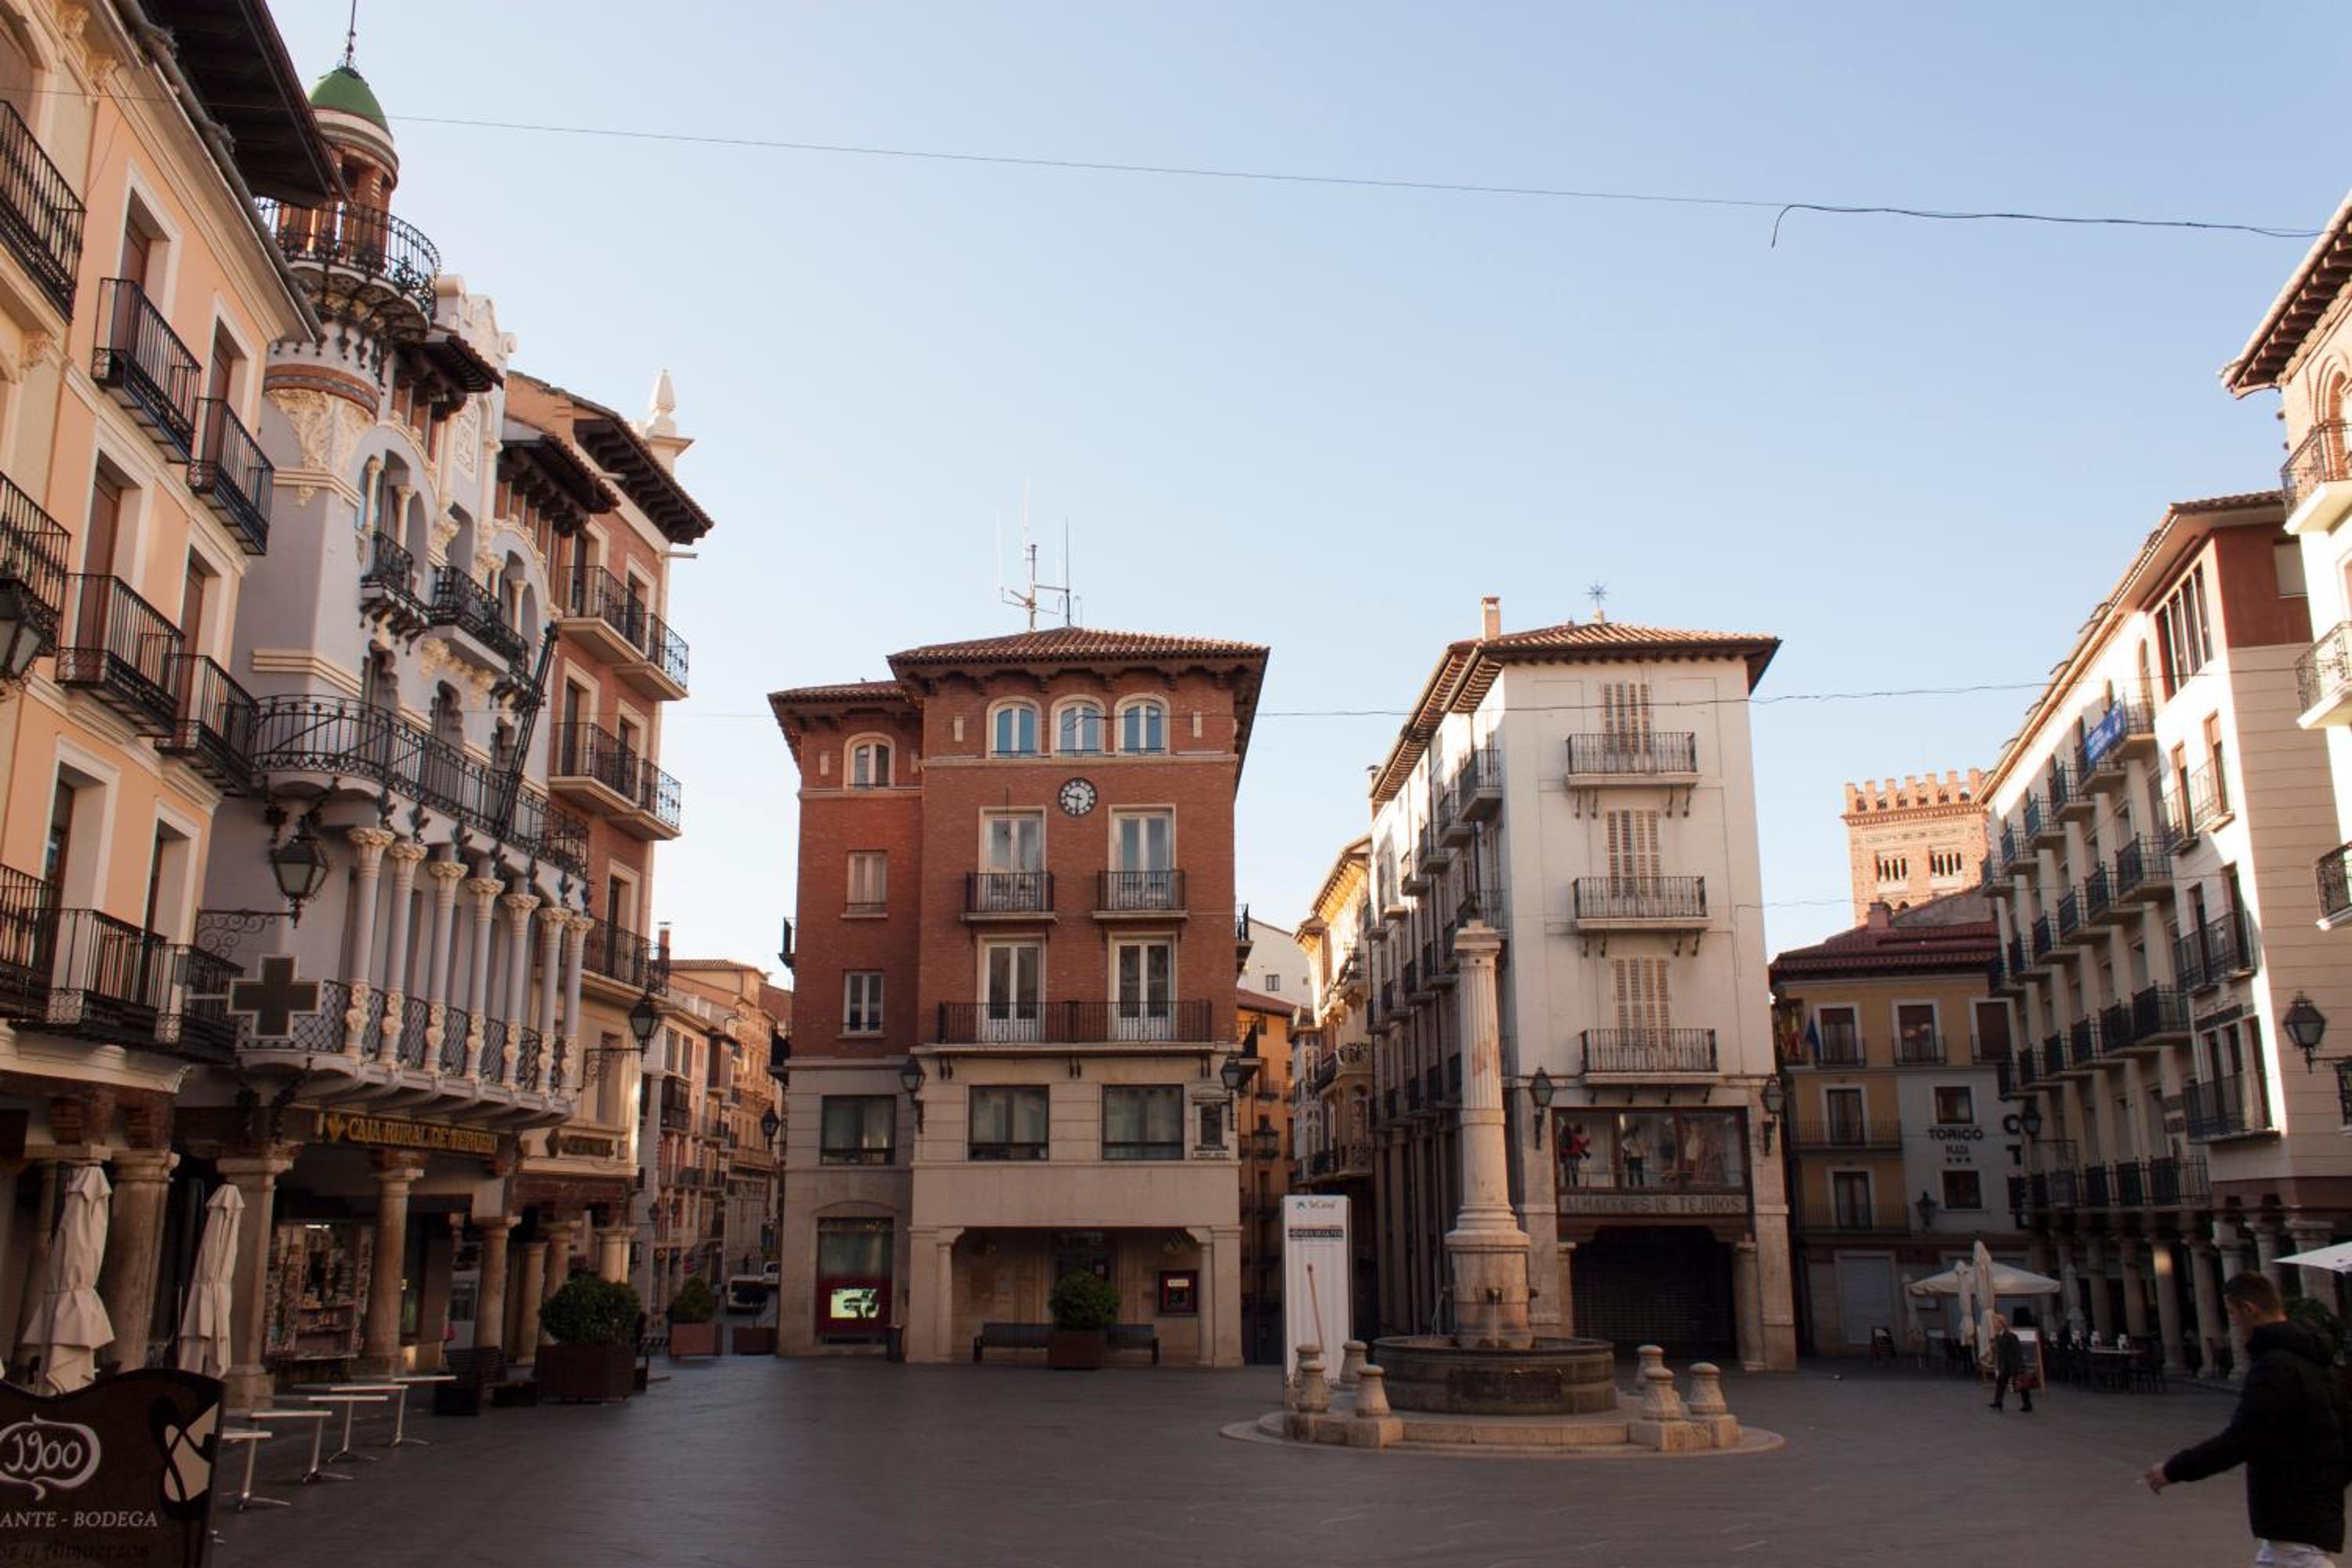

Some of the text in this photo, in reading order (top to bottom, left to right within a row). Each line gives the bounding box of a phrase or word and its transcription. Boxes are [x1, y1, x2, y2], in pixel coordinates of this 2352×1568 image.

[1927, 1128, 1984, 1142] TORICO
[1679, 1196, 1744, 1213] TEJIDOS
[2, 1431, 84, 1475] 1900
[72, 1510, 158, 1529] BODEGA
